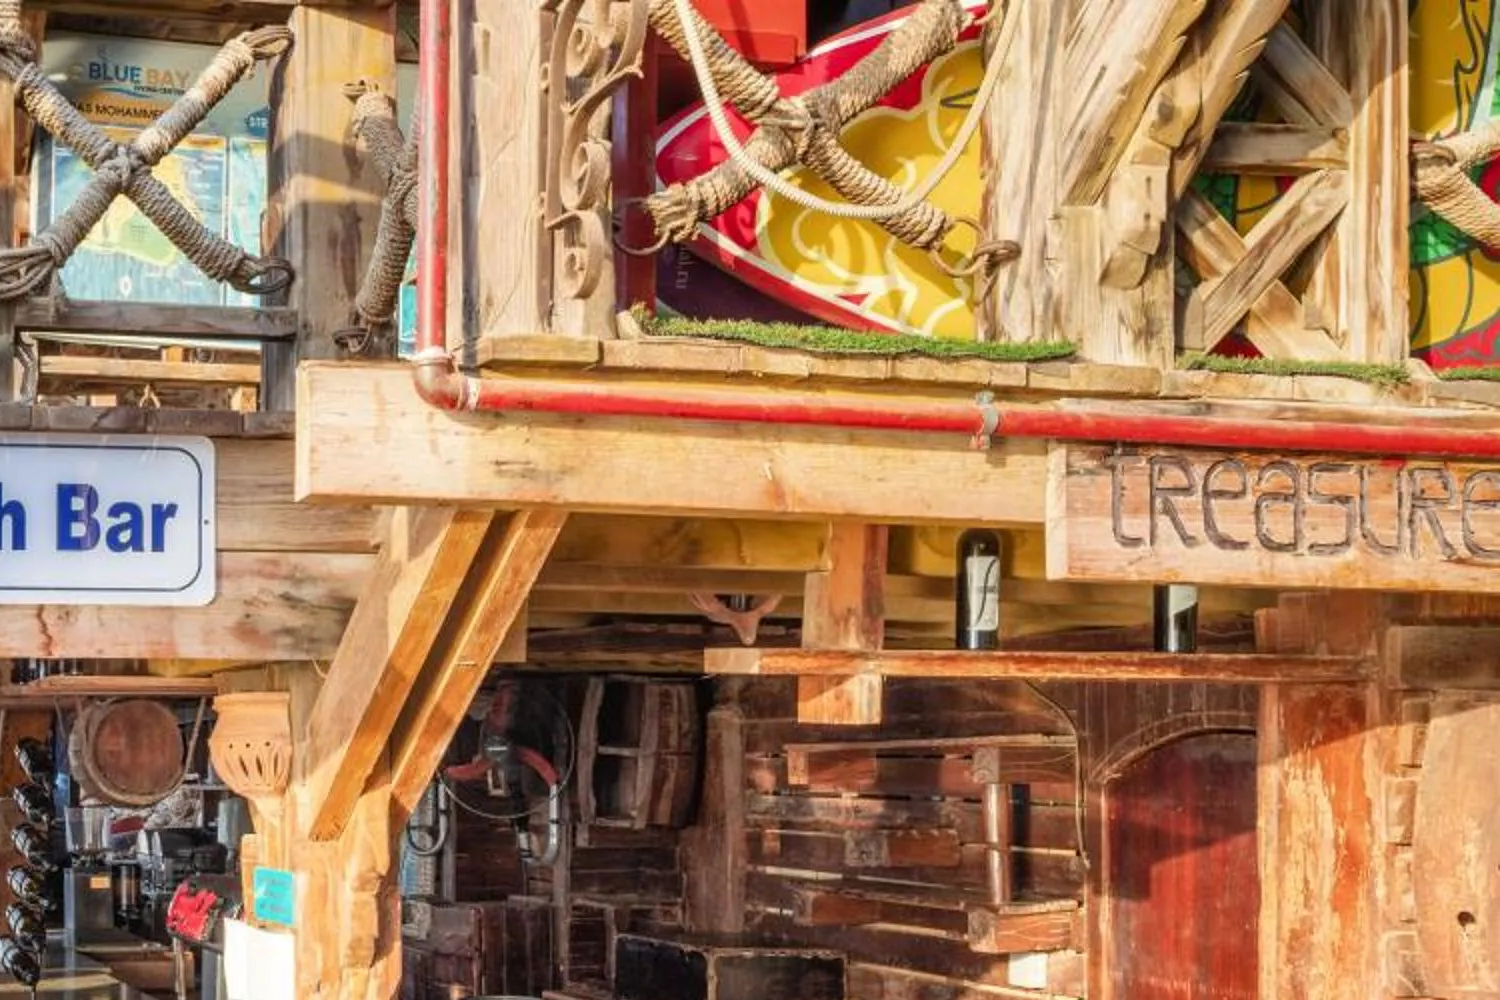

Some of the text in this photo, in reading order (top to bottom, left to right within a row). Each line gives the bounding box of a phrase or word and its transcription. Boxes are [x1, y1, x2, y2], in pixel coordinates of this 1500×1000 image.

[88, 62, 191, 87] BLUE BAY
[95, 104, 164, 120] MOHAMME
[56, 482, 179, 553] Bar
